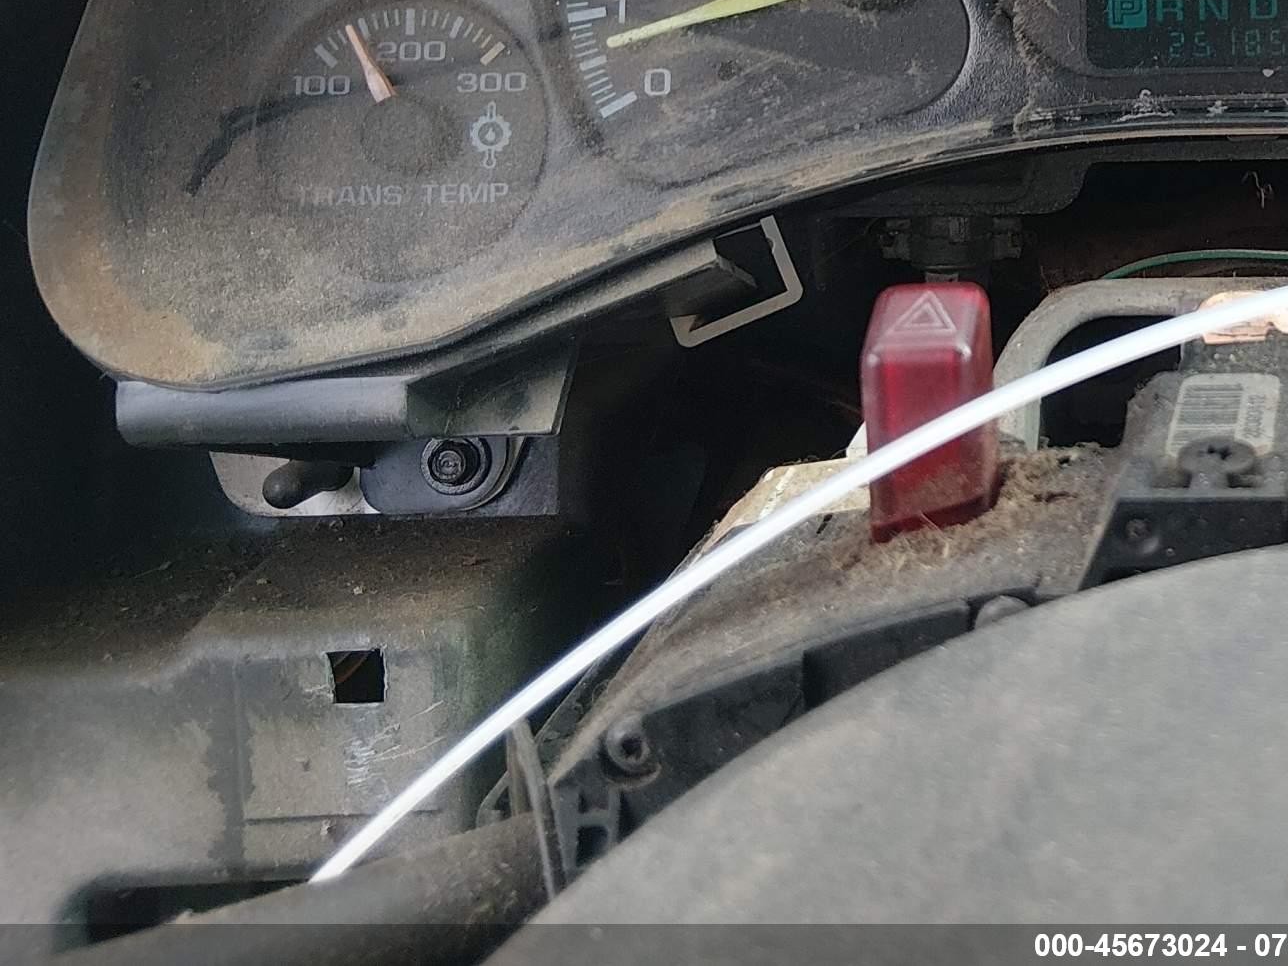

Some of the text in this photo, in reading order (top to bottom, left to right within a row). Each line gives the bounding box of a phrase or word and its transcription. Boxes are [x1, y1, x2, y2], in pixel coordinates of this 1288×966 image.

[377, 41, 446, 62] 200
[294, 75, 350, 96] 100
[457, 72, 527, 92] 300
[643, 68, 671, 96] 0
[299, 183, 509, 206] TRANS TEMP
